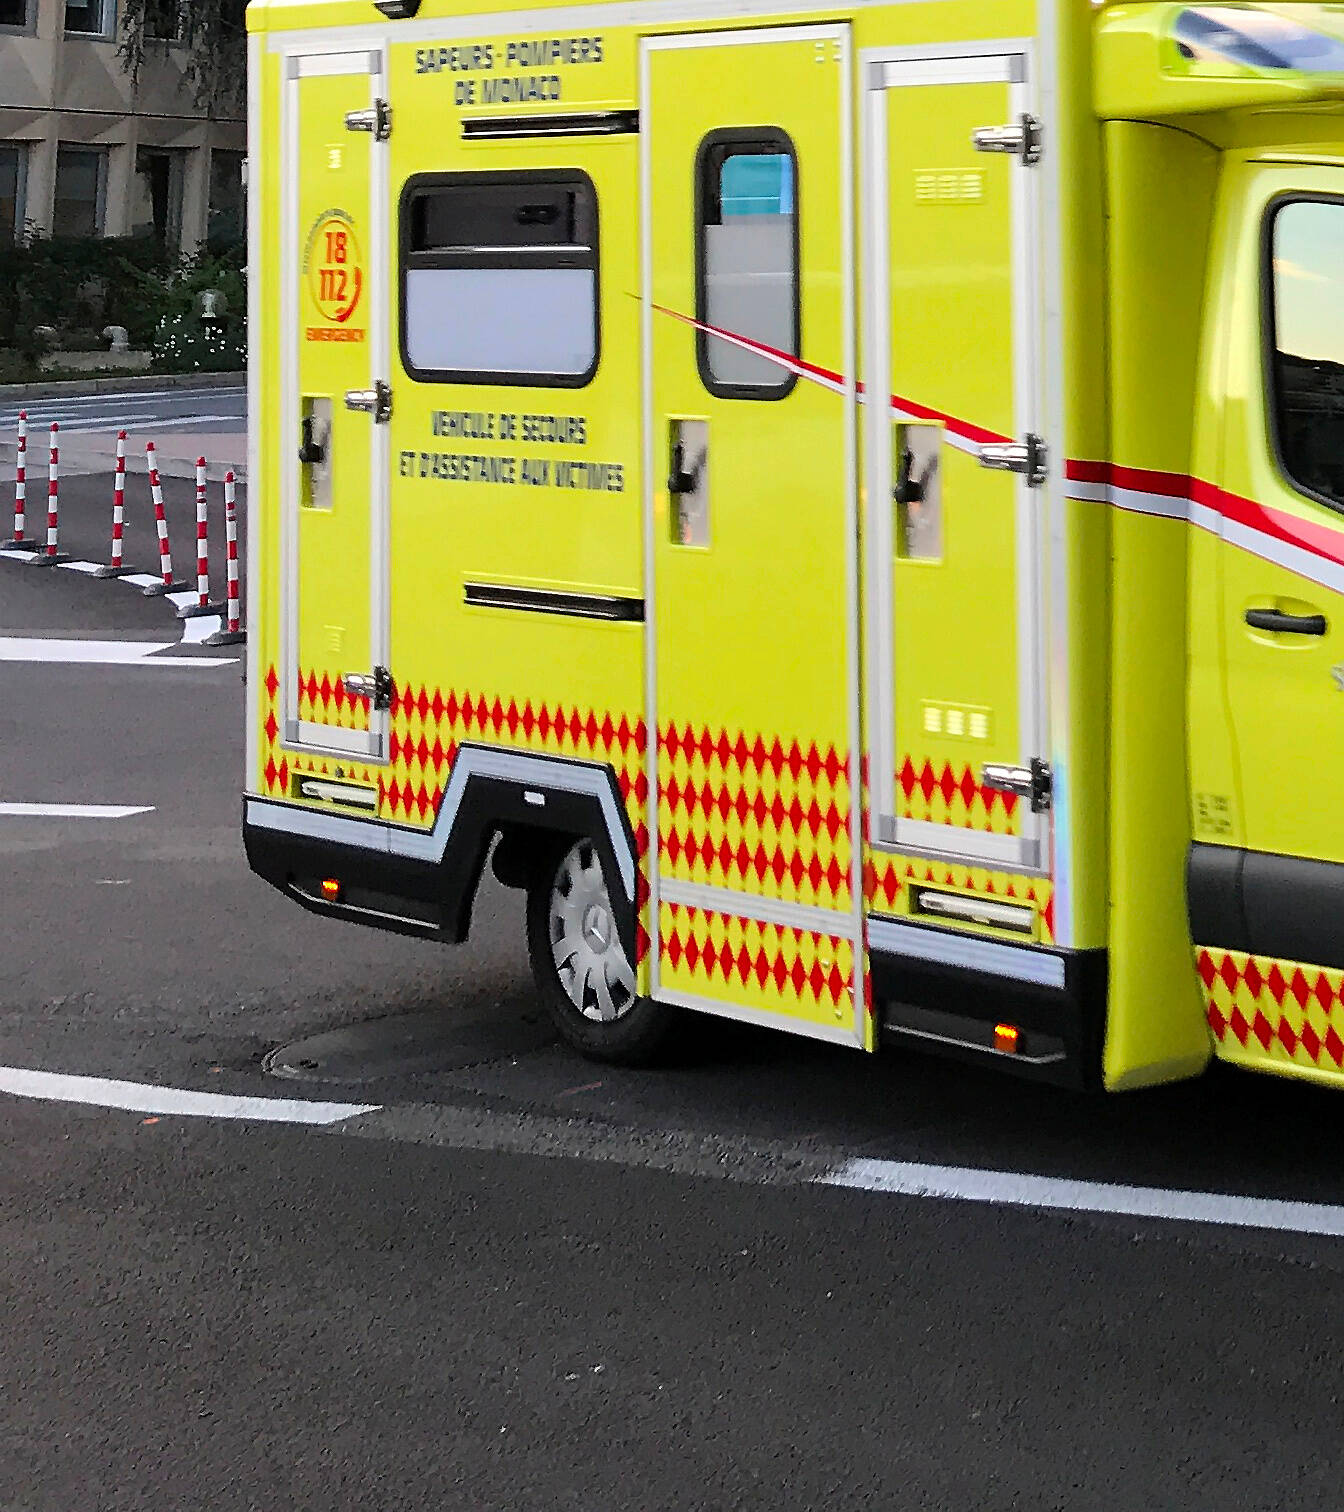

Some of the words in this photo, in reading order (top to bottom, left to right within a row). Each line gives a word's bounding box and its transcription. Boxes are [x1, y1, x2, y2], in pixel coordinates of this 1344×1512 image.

[455, 80, 475, 106] DE
[481, 75, 562, 104] MONACO
[325, 231, 348, 264] 18
[319, 269, 347, 302] 112
[499, 413, 516, 440] DE
[521, 414, 587, 445] SECOURS
[400, 450, 416, 477] ET
[519, 458, 550, 487] AUX
[554, 460, 624, 493] VICTIMES
